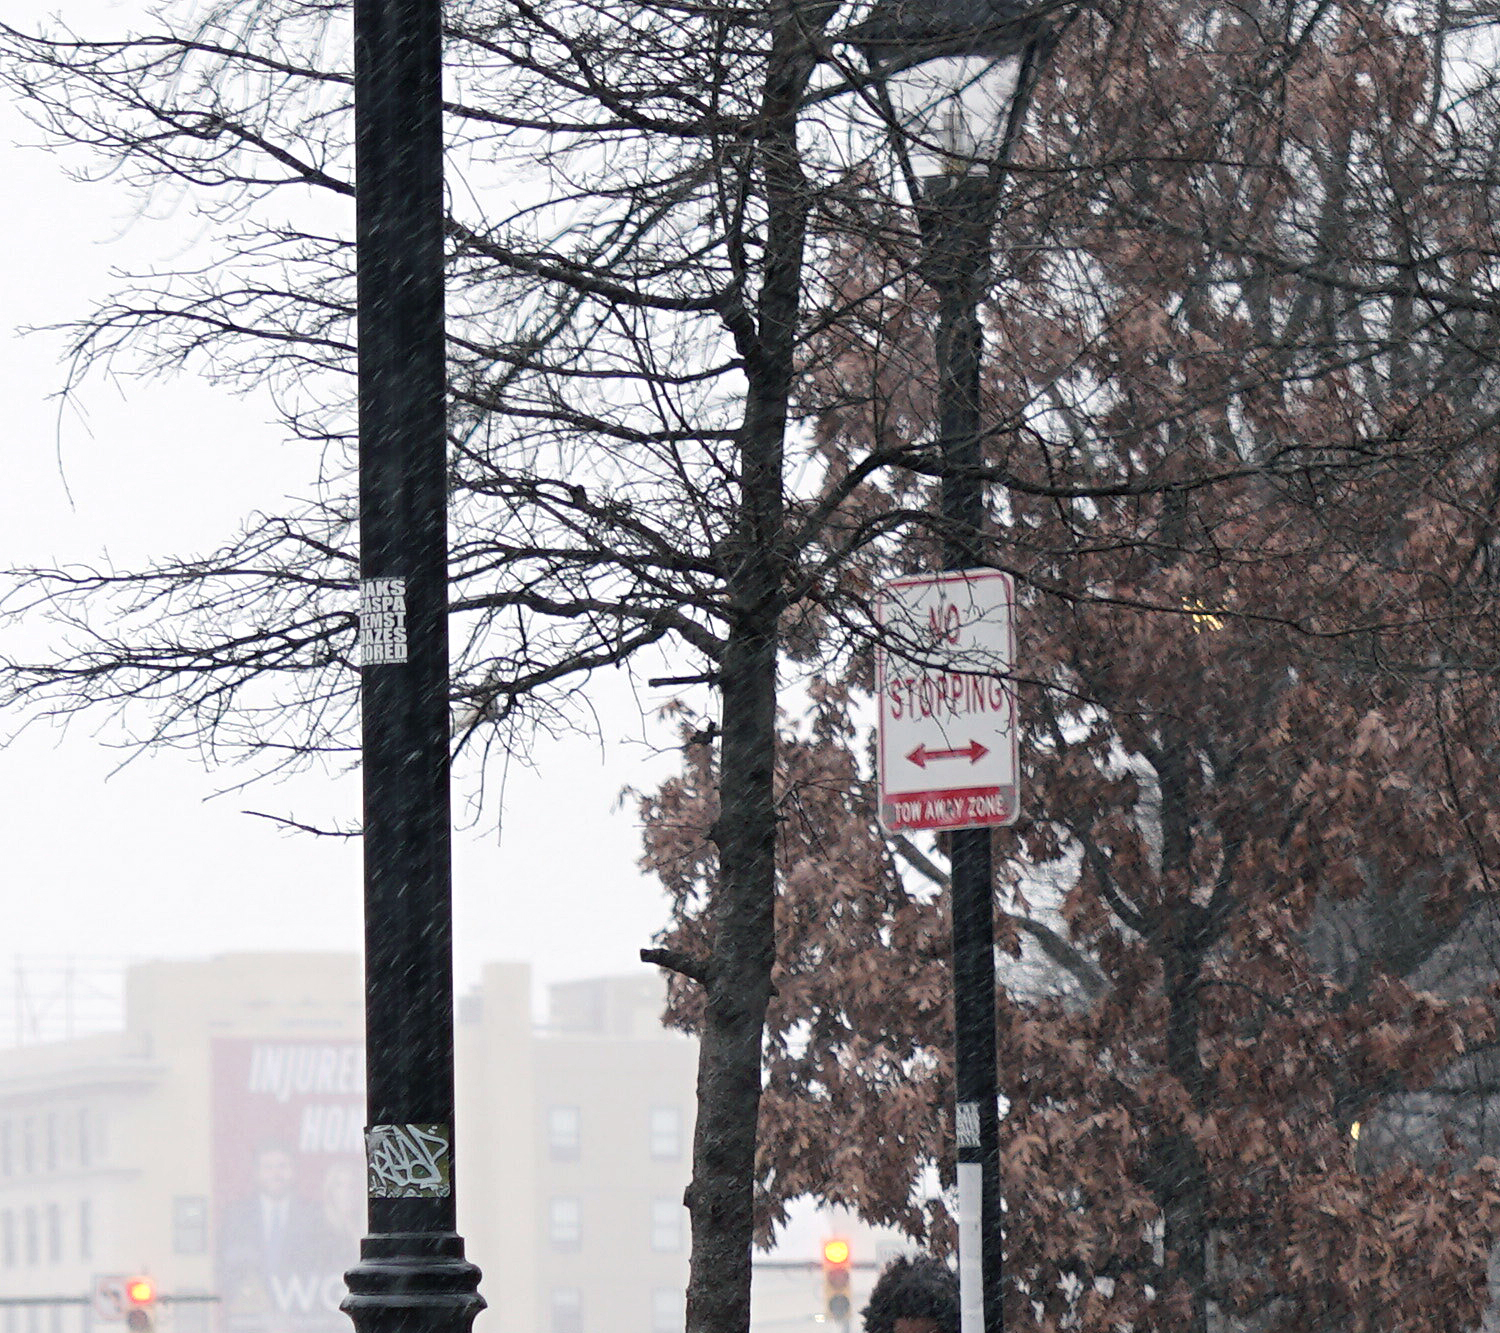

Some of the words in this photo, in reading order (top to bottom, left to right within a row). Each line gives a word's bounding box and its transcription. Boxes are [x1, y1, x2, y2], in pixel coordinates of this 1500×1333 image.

[929, 603, 961, 646] NO
[890, 670, 1003, 720] STOPPING
[894, 801, 922, 824] TOW
[966, 794, 1006, 818] ZONE
[249, 1044, 367, 1103] INJURE
